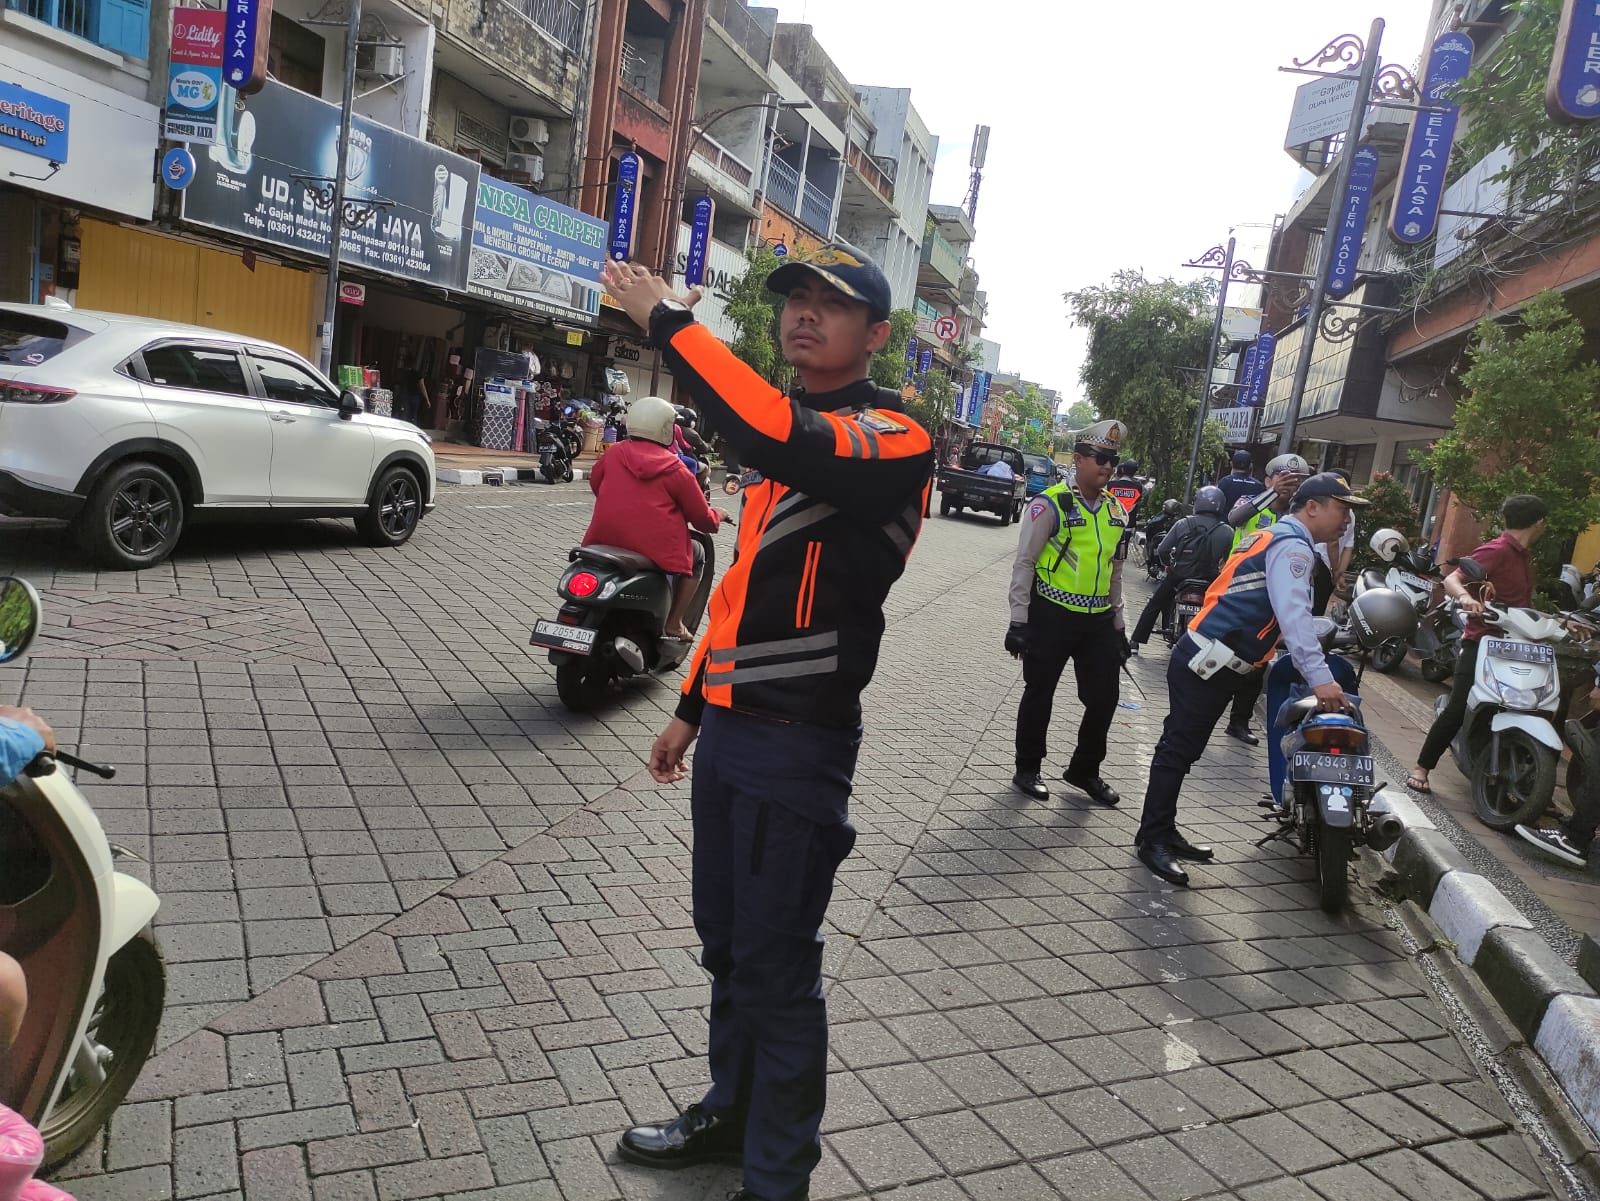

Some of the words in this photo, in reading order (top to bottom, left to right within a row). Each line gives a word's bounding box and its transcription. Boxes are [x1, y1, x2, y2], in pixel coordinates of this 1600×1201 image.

[186, 24, 220, 48] Lidily
[232, 20, 247, 58] JAYA
[177, 84, 200, 99] MG
[20, 129, 47, 146] Kopi
[1408, 164, 1433, 216] PLASA
[262, 175, 293, 205] UD.
[382, 215, 422, 245] JAYA
[477, 183, 530, 224] NISA
[533, 204, 605, 249] CARPET
[1346, 196, 1361, 229] RIEN
[243, 212, 265, 229] Telp.
[267, 220, 295, 238] (0361)
[296, 228, 326, 245] 432421
[364, 246, 381, 260] Fax.
[382, 251, 405, 268] (0361)
[405, 258, 431, 273] 423094
[255, 202, 266, 215] Jl.
[268, 206, 294, 222] Gajah
[296, 213, 319, 229] Mada
[351, 231, 387, 250] Denpasar
[410, 247, 425, 261] Bali
[617, 218, 628, 240] MADA
[692, 232, 703, 275] HAWAI
[1335, 235, 1352, 275] PAOLO
[537, 622, 549, 633] DK
[552, 626, 576, 639] 2055
[576, 630, 593, 642] ADY
[1488, 640, 1502, 649] DK
[1295, 754, 1312, 767] DK
[1317, 756, 1346, 769] 4943
[1356, 760, 1373, 771] AU
